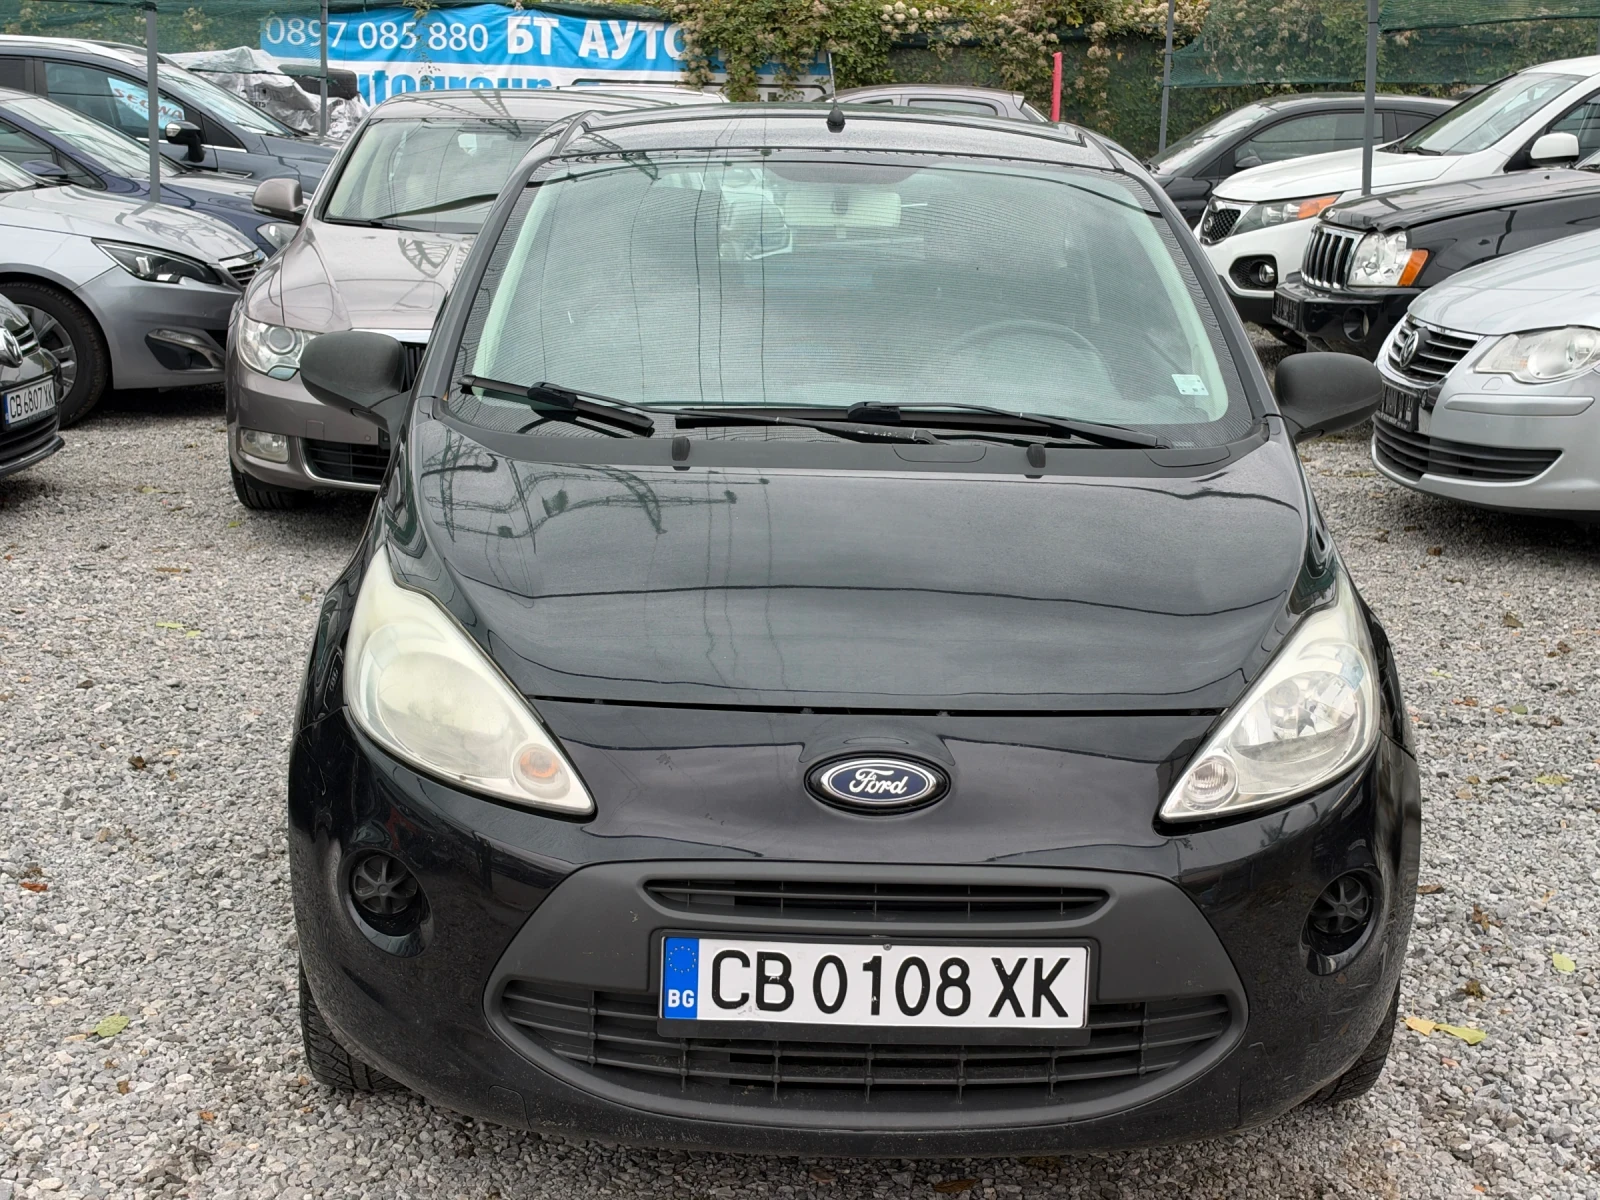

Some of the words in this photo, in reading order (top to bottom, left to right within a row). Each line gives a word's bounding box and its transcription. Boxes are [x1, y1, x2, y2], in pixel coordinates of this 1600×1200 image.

[266, 17, 347, 48] 0897
[358, 22, 417, 50] 085
[427, 22, 488, 52] 880
[507, 16, 559, 55] БТ
[24, 387, 42, 414] 6807
[849, 768, 909, 794] Ford
[668, 989, 695, 1008] BG
[711, 949, 794, 1012] CB
[812, 955, 972, 1018] 0108
[988, 957, 1071, 1018] XK
